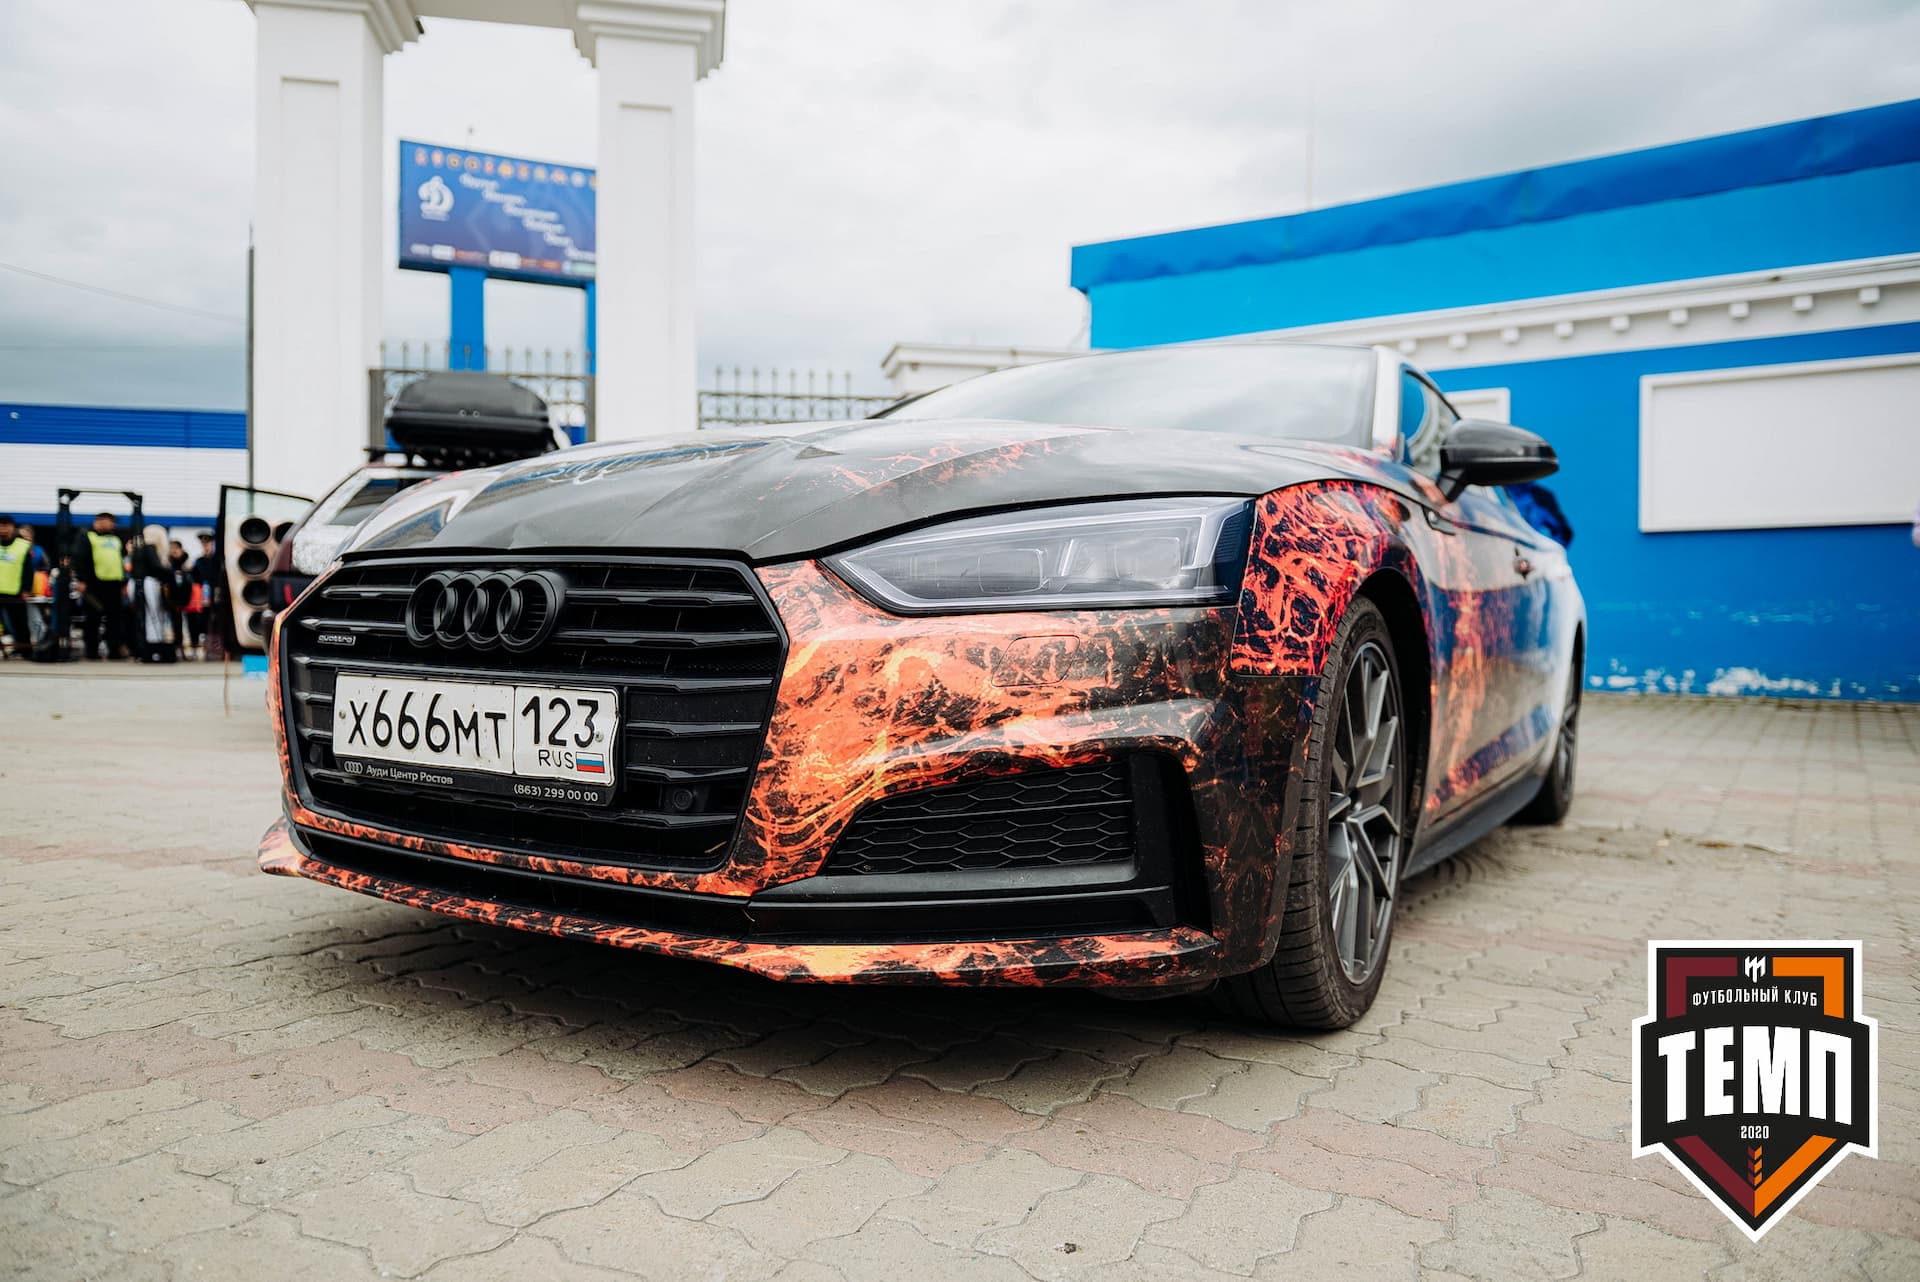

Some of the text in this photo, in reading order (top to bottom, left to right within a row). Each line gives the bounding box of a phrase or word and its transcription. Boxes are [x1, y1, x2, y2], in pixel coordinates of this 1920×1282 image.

[318, 634, 353, 644] quattro
[348, 689, 600, 760] Х666МТ 123
[538, 749, 575, 769] RUS
[366, 765, 454, 785] Ауди Центр Ростов
[513, 784, 599, 802] (863) 299 00 00
